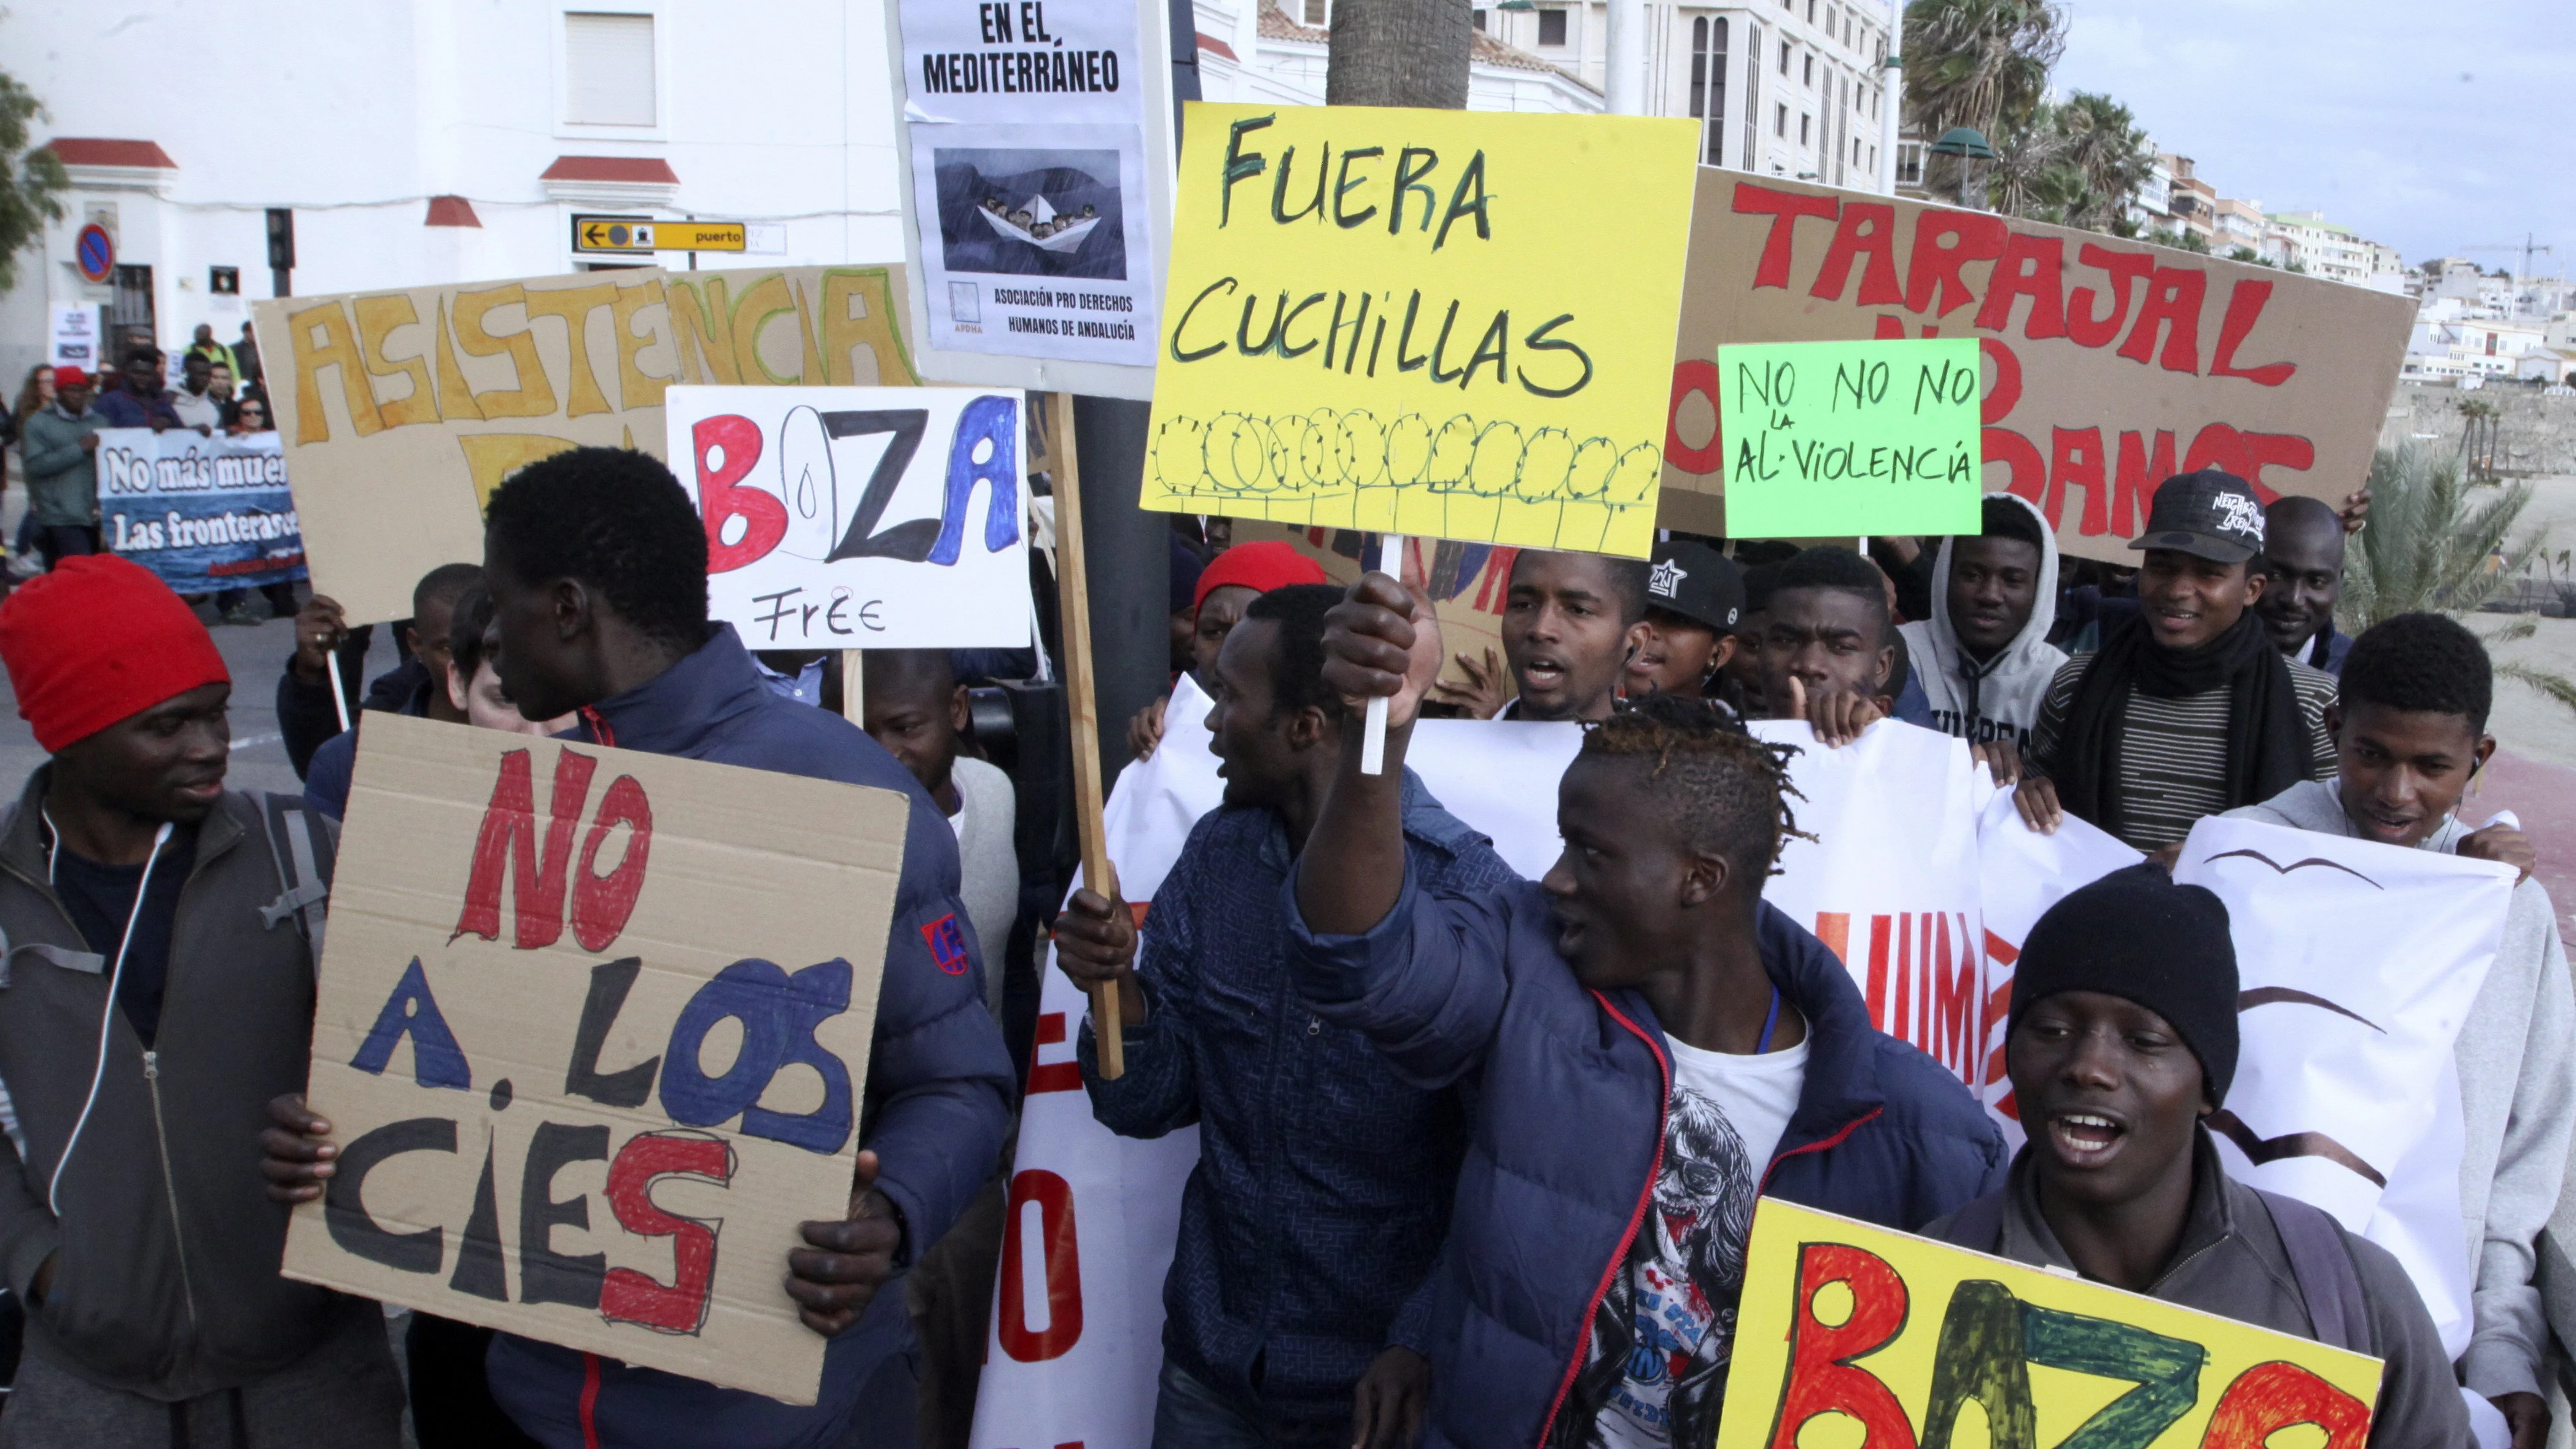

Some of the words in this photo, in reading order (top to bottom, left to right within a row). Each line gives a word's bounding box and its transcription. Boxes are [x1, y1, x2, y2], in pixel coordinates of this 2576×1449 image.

[979, 2, 1013, 44] EN
[1021, 2, 1051, 43] EL
[923, 37, 1119, 93] MEDITERRÁNEO
[1218, 112, 1500, 255] FUERA
[696, 231, 741, 243] puerto
[994, 286, 1053, 307] ASOCIACIÓN
[1056, 292, 1075, 309] PRO
[1080, 293, 1134, 313] DERECHOS
[1731, 182, 2297, 386] TARAJAL
[954, 324, 983, 335] APDHA
[1008, 316, 1059, 335] HUMANOS
[1062, 319, 1075, 336] DE
[1078, 319, 1135, 341] ANDALUCÍA
[288, 268, 923, 447] ASISTENCIA
[1738, 359, 1796, 413] NO
[1832, 359, 1889, 413] NO
[1913, 359, 1975, 415] NO
[1770, 409, 1796, 430] LA
[106, 447, 152, 492] No
[156, 446, 211, 491] más
[691, 395, 1021, 575] BOZA
[113, 513, 165, 551] Las
[168, 510, 283, 548] fronteras
[447, 744, 653, 952] NO
[564, 956, 854, 1156] LOS
